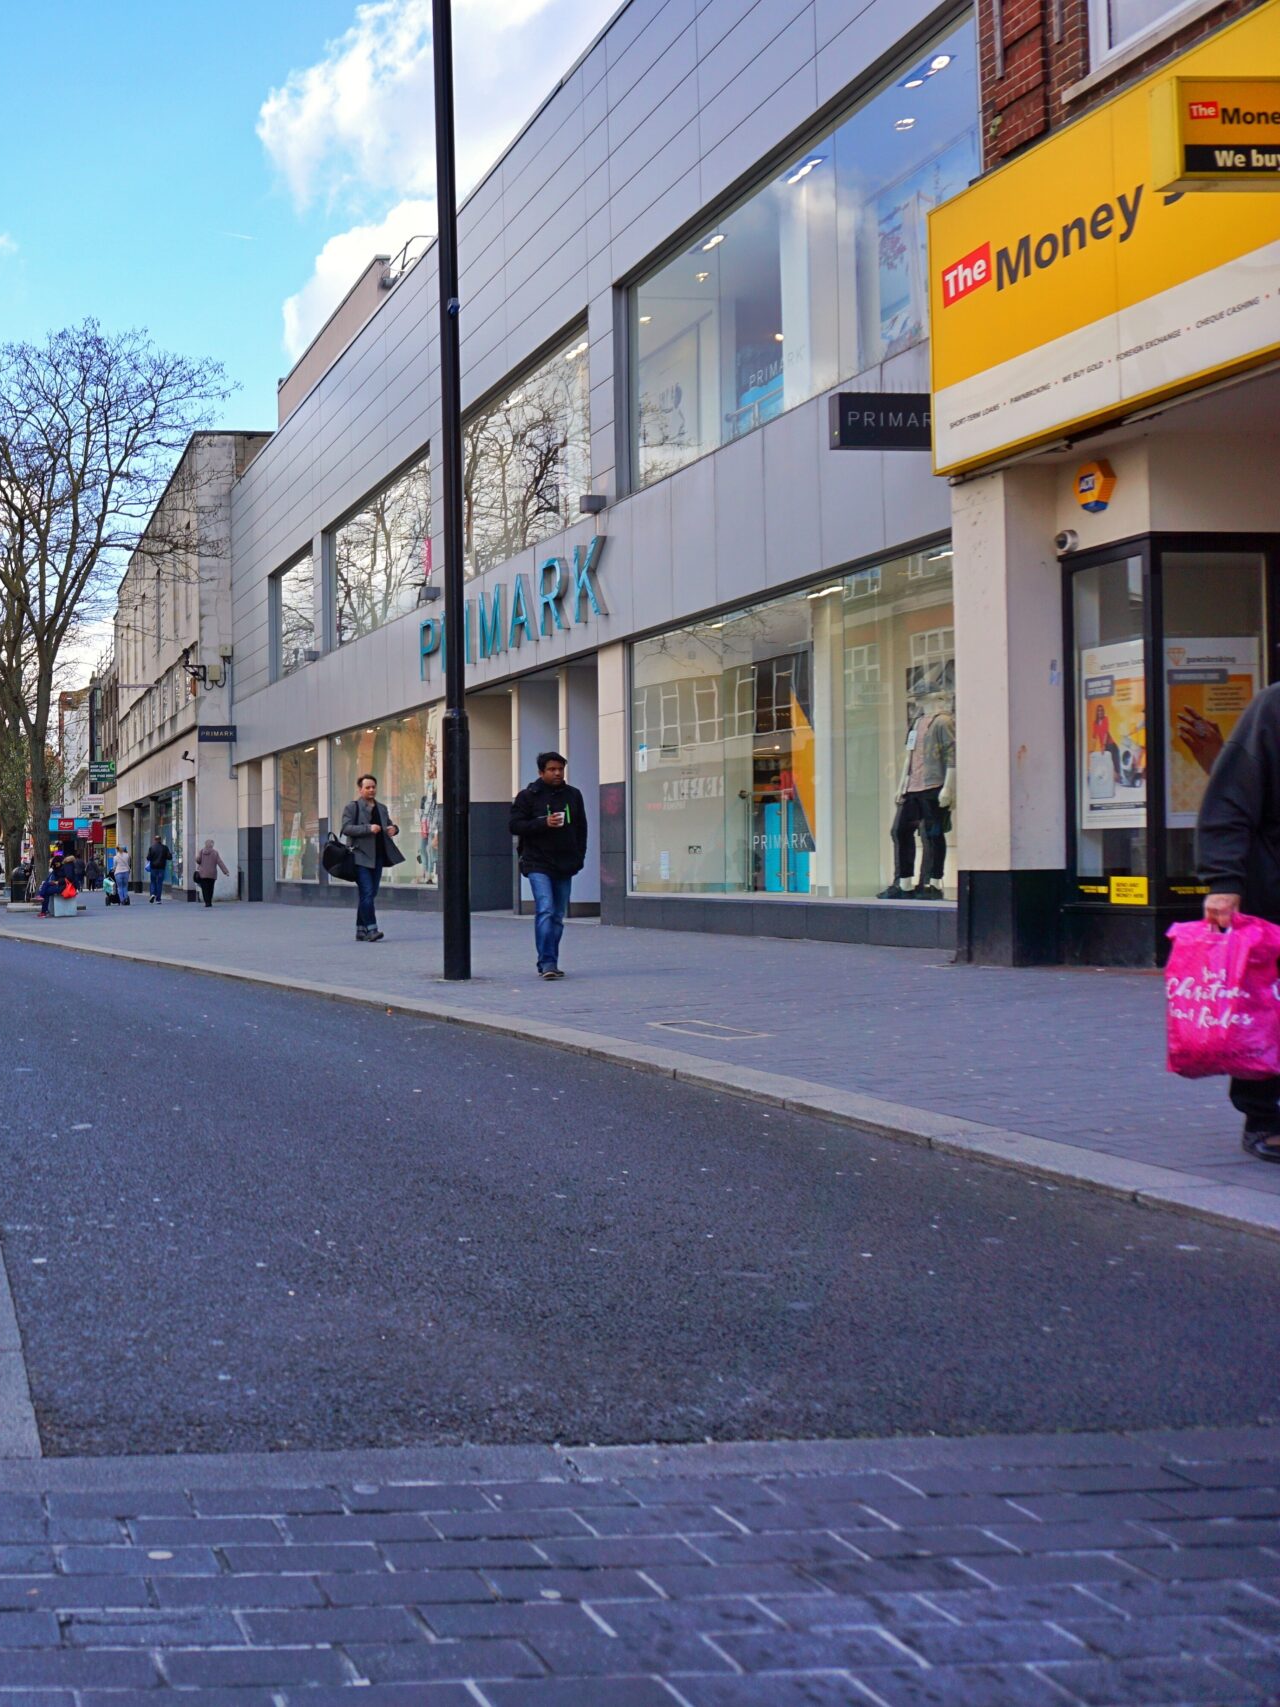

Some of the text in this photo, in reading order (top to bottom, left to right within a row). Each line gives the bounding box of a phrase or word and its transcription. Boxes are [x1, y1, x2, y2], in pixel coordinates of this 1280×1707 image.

[1190, 104, 1280, 125] The Mone
[1214, 150, 1246, 167] We
[944, 184, 1144, 299] The Money
[1086, 361, 1104, 374] GOLD
[1145, 328, 1181, 350] EXCHANGE
[1195, 311, 1225, 329] CHEQUE
[1226, 296, 1260, 317] CASHING
[848, 411, 932, 427] PRIMAR
[753, 833, 808, 850] PRIMARK
